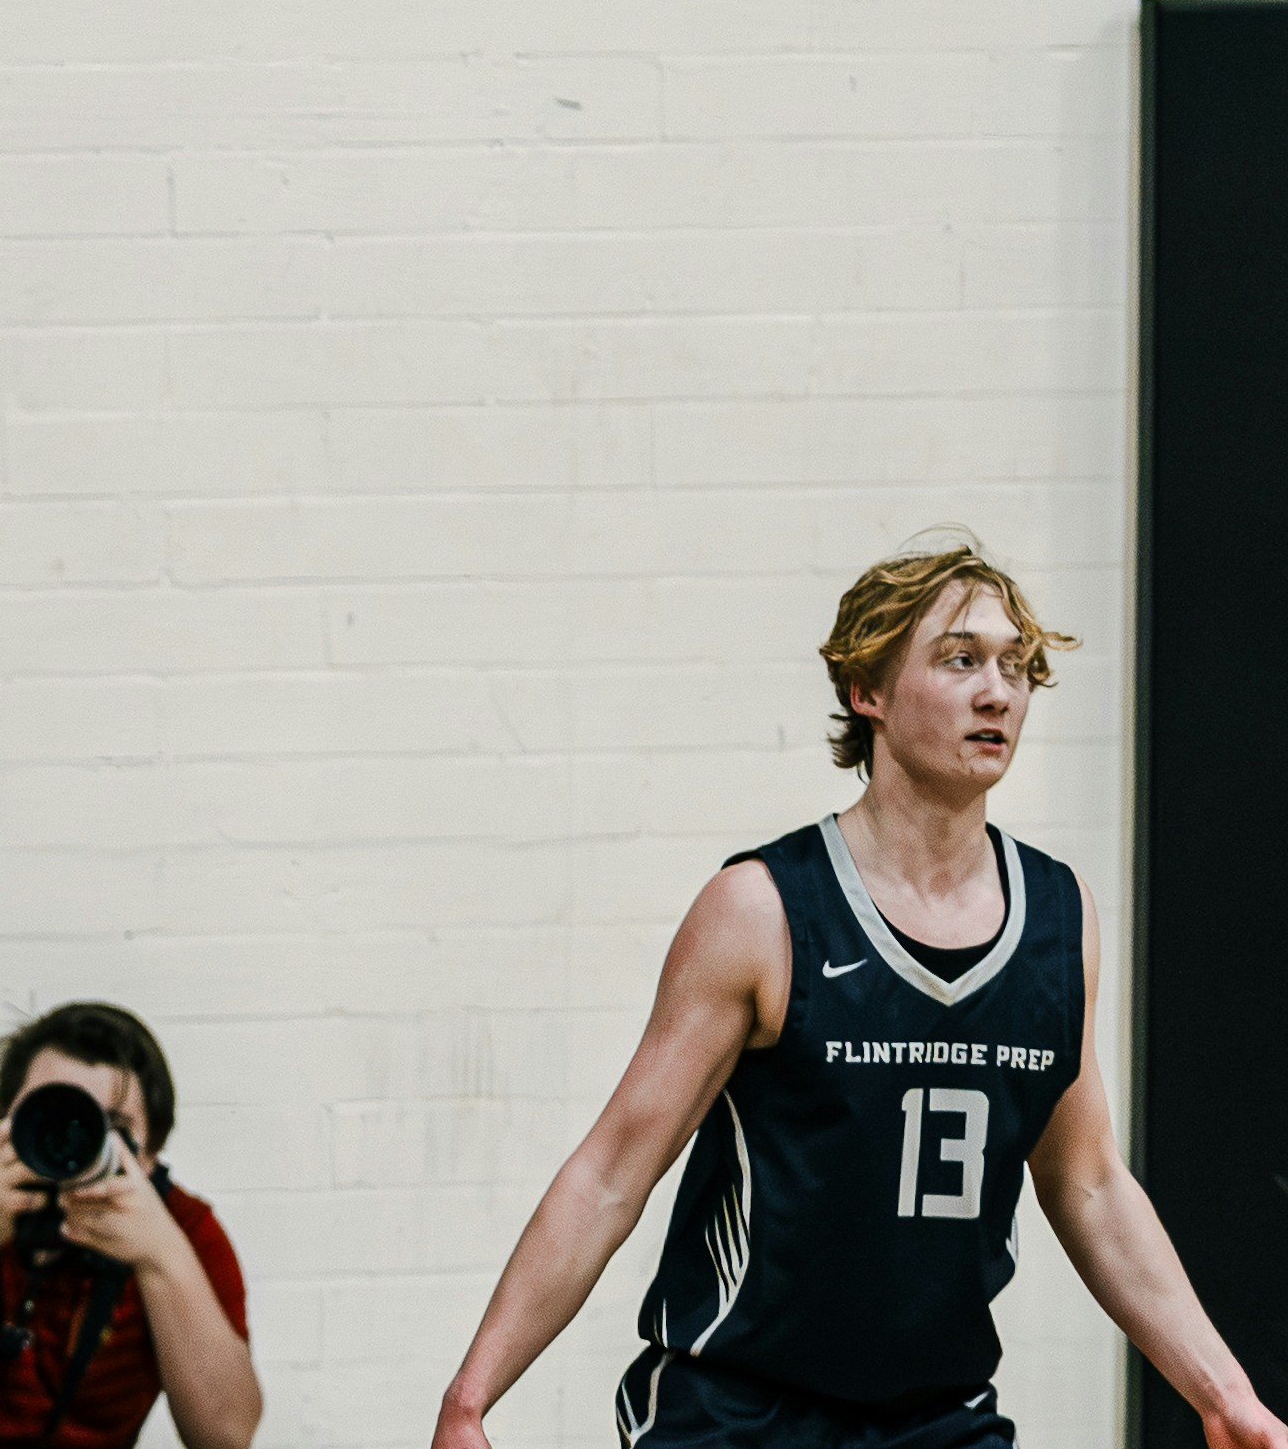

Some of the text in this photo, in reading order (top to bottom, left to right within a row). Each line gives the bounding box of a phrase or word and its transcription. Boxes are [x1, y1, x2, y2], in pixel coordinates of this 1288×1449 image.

[825, 1040, 1055, 1072] FLINTRIDGE PREP
[897, 1087, 990, 1220] 13
